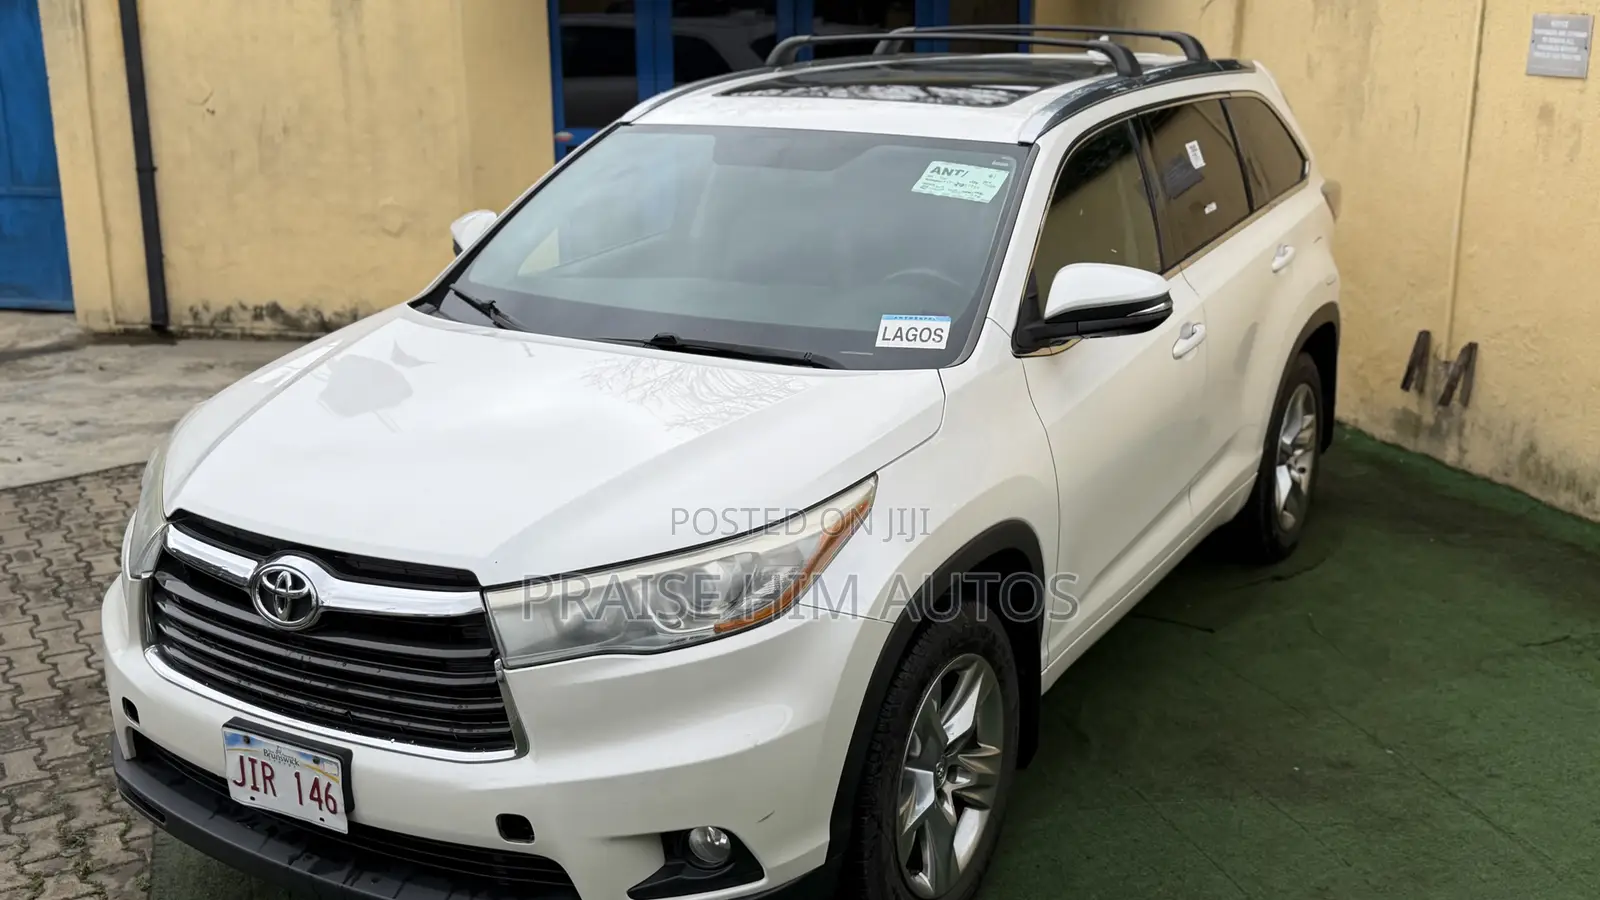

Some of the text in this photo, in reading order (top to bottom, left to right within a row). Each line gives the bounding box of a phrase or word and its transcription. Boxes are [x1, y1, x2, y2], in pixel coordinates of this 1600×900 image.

[882, 326, 944, 343] LAGOS
[233, 755, 338, 815] JIR 146
